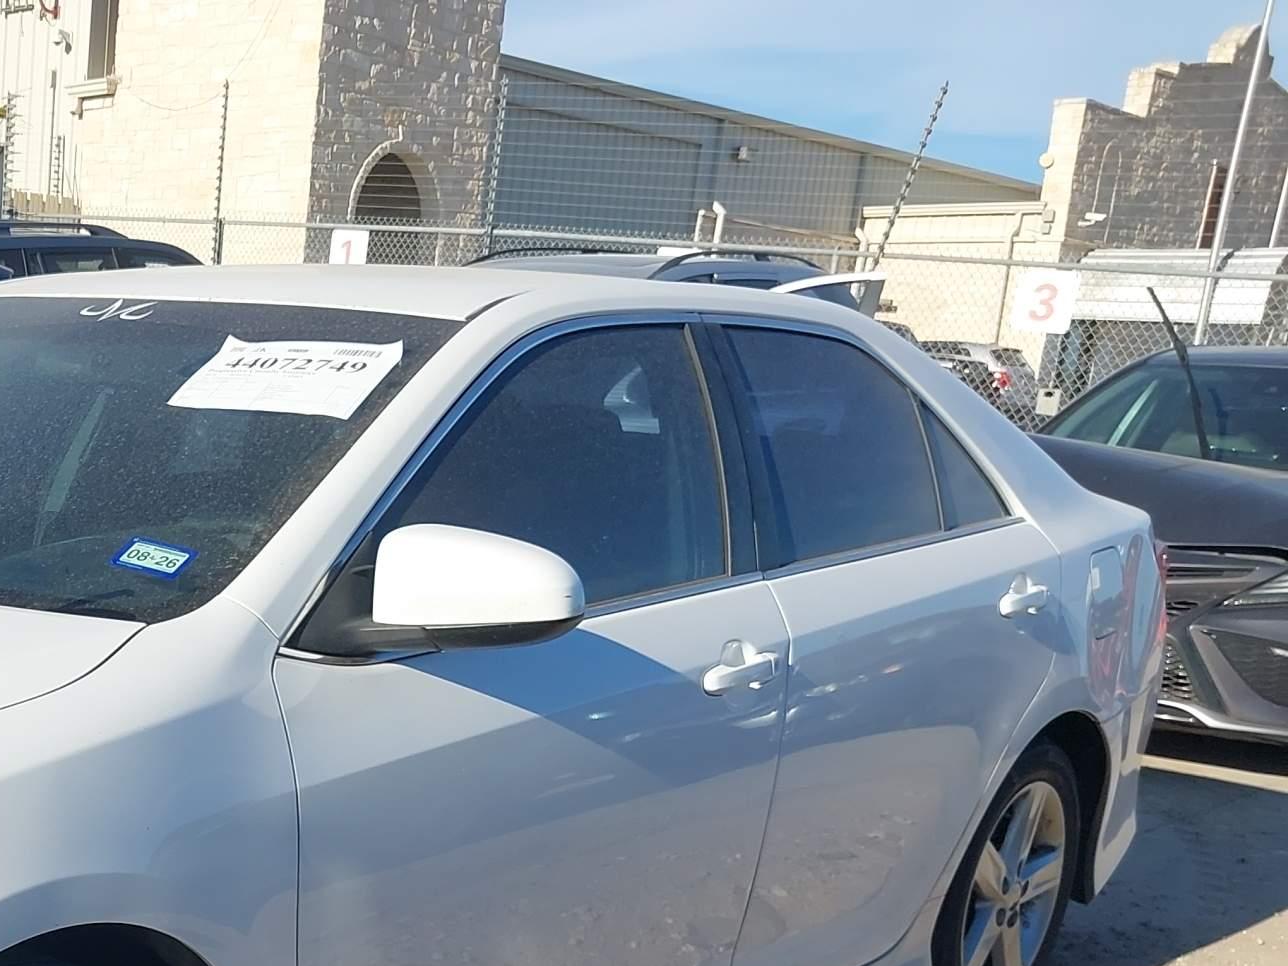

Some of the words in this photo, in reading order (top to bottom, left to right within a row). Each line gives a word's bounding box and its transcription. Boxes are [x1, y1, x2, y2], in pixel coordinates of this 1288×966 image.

[341, 239, 352, 264] 1
[1028, 283, 1059, 323] 3
[225, 356, 369, 374] 44072749
[126, 549, 150, 562] 08
[154, 555, 180, 569] 26
